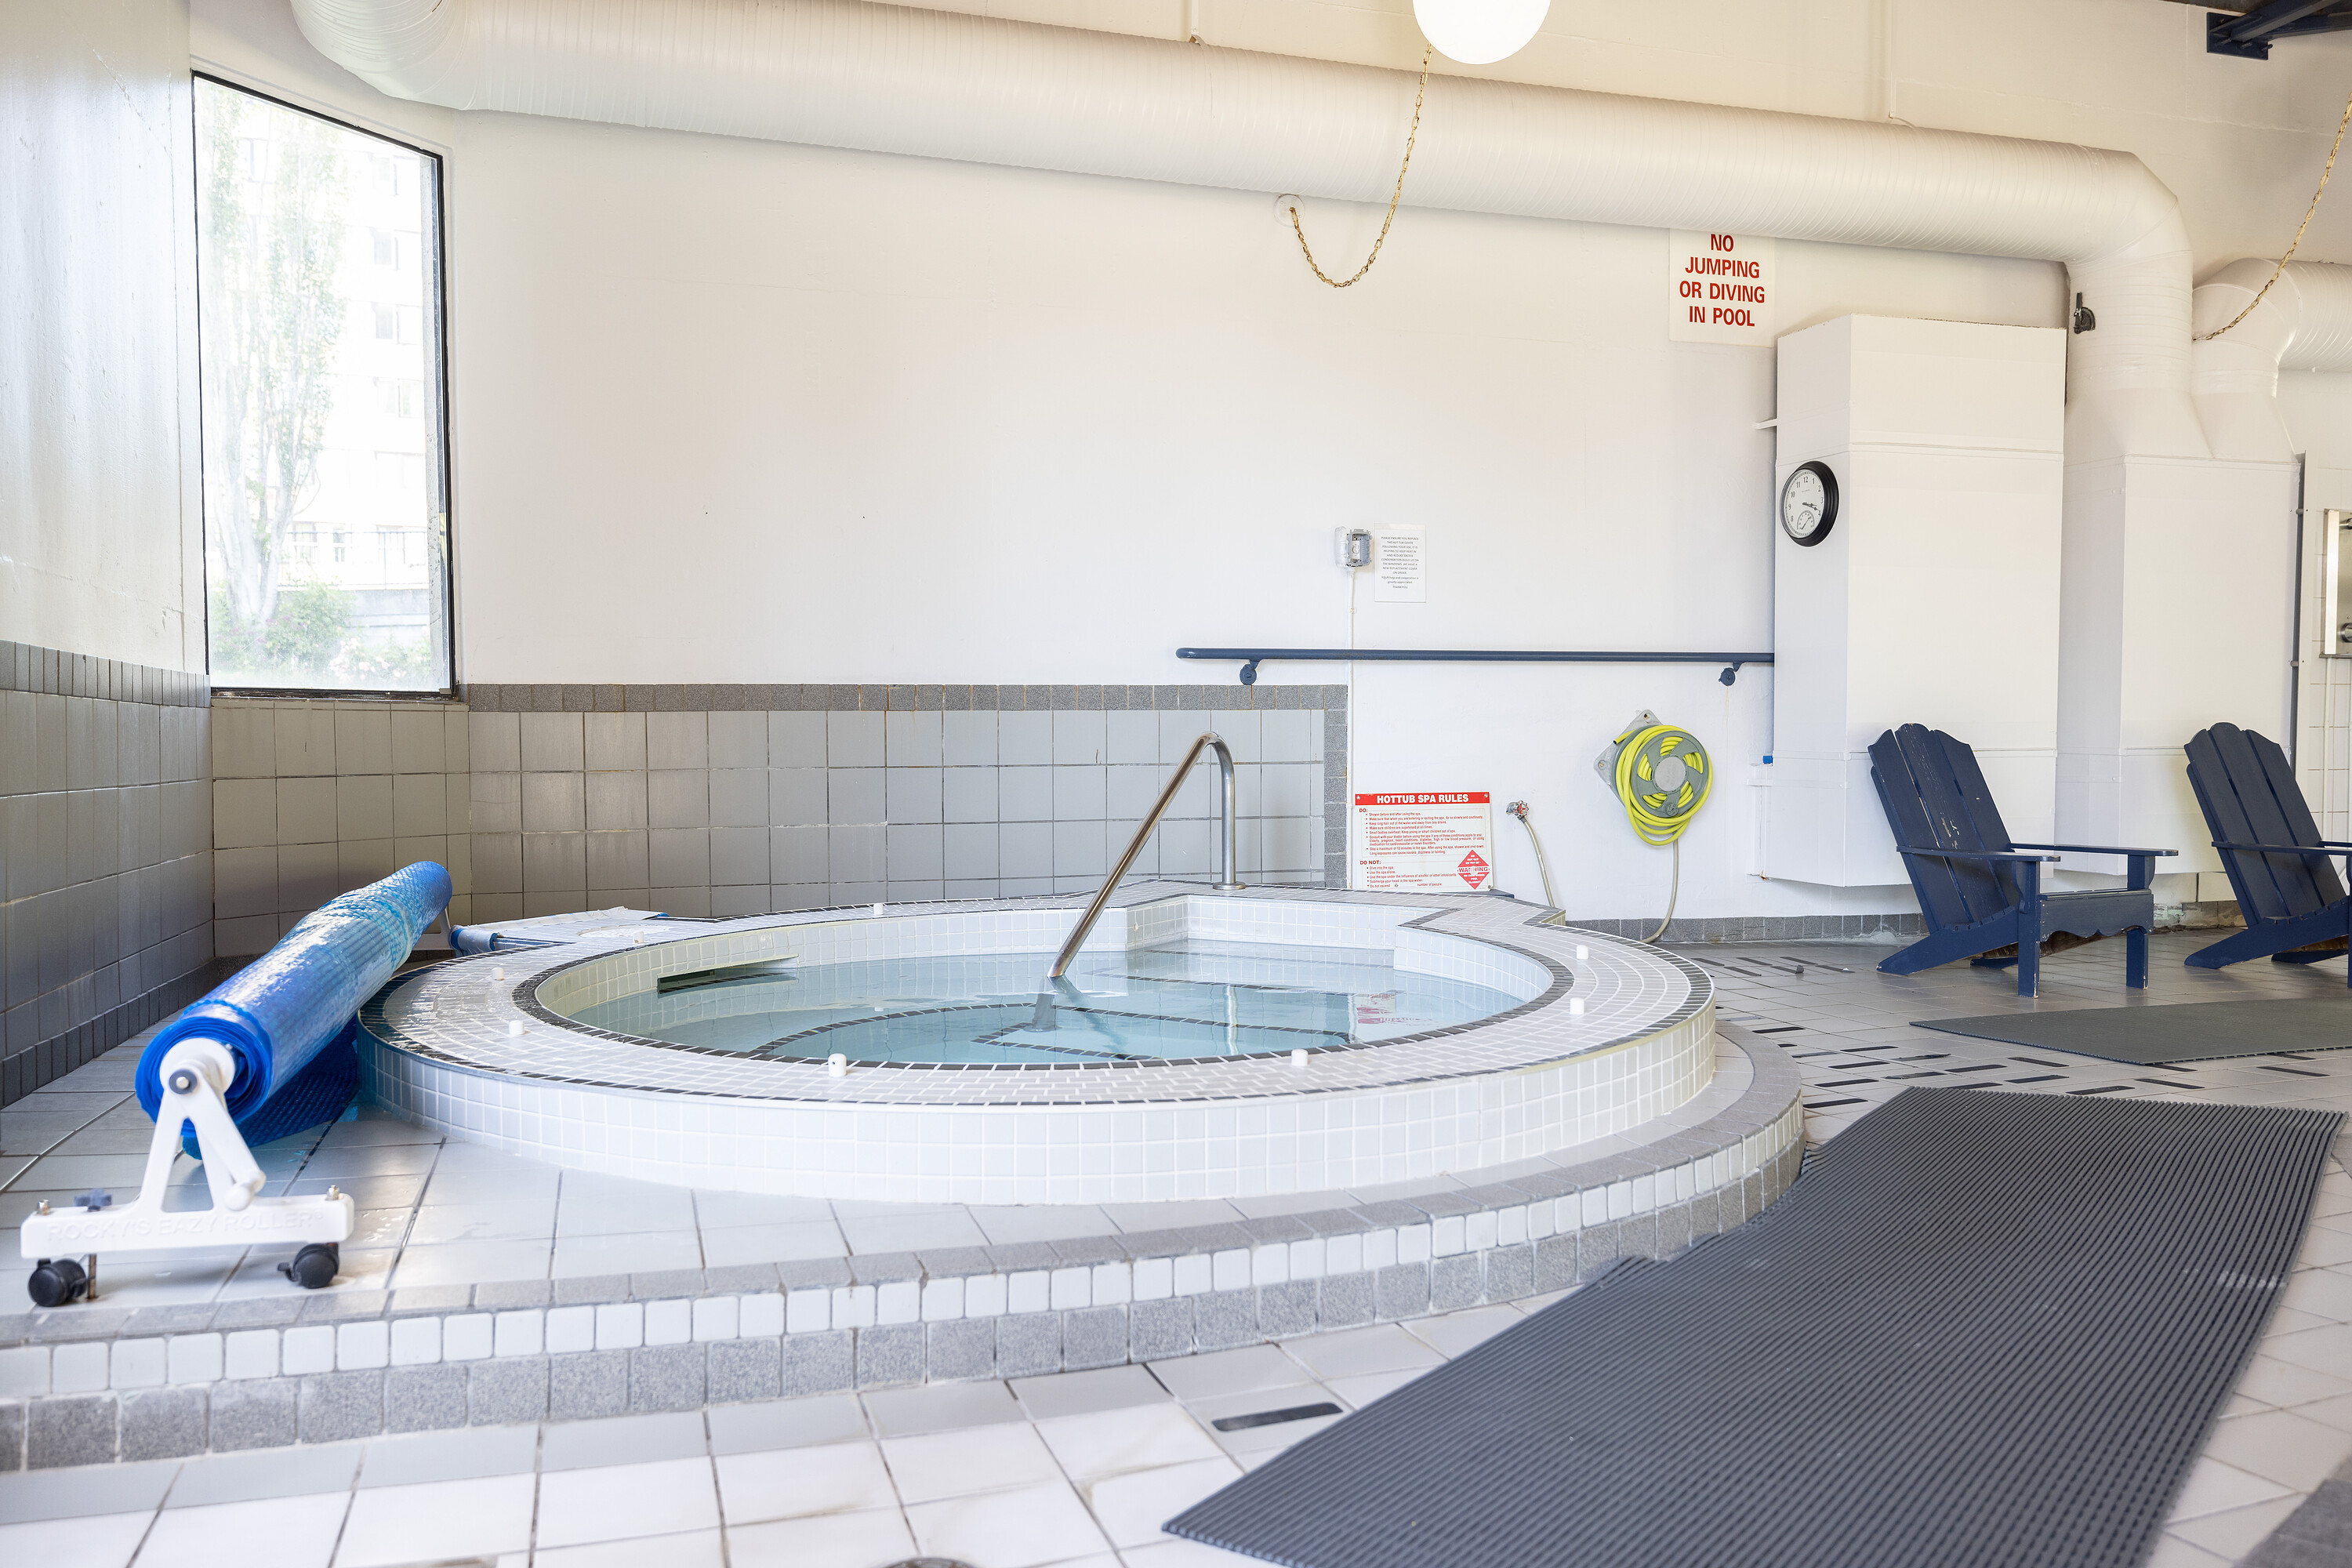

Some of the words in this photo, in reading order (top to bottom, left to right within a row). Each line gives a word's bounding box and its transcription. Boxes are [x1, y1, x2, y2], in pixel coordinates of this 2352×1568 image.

[1711, 234, 1734, 252] NO
[1685, 257, 1759, 279] JUMPING
[1679, 280, 1702, 298] OR
[1710, 283, 1765, 303] DIVING
[1689, 306, 1705, 323] IN
[1713, 307, 1755, 327] POOL
[1377, 795, 1415, 804] HOTTUB
[1418, 795, 1436, 803] SPA
[1438, 794, 1469, 802] RULES
[47, 1218, 151, 1242] ROCKY'S
[157, 1216, 218, 1236] EAZY
